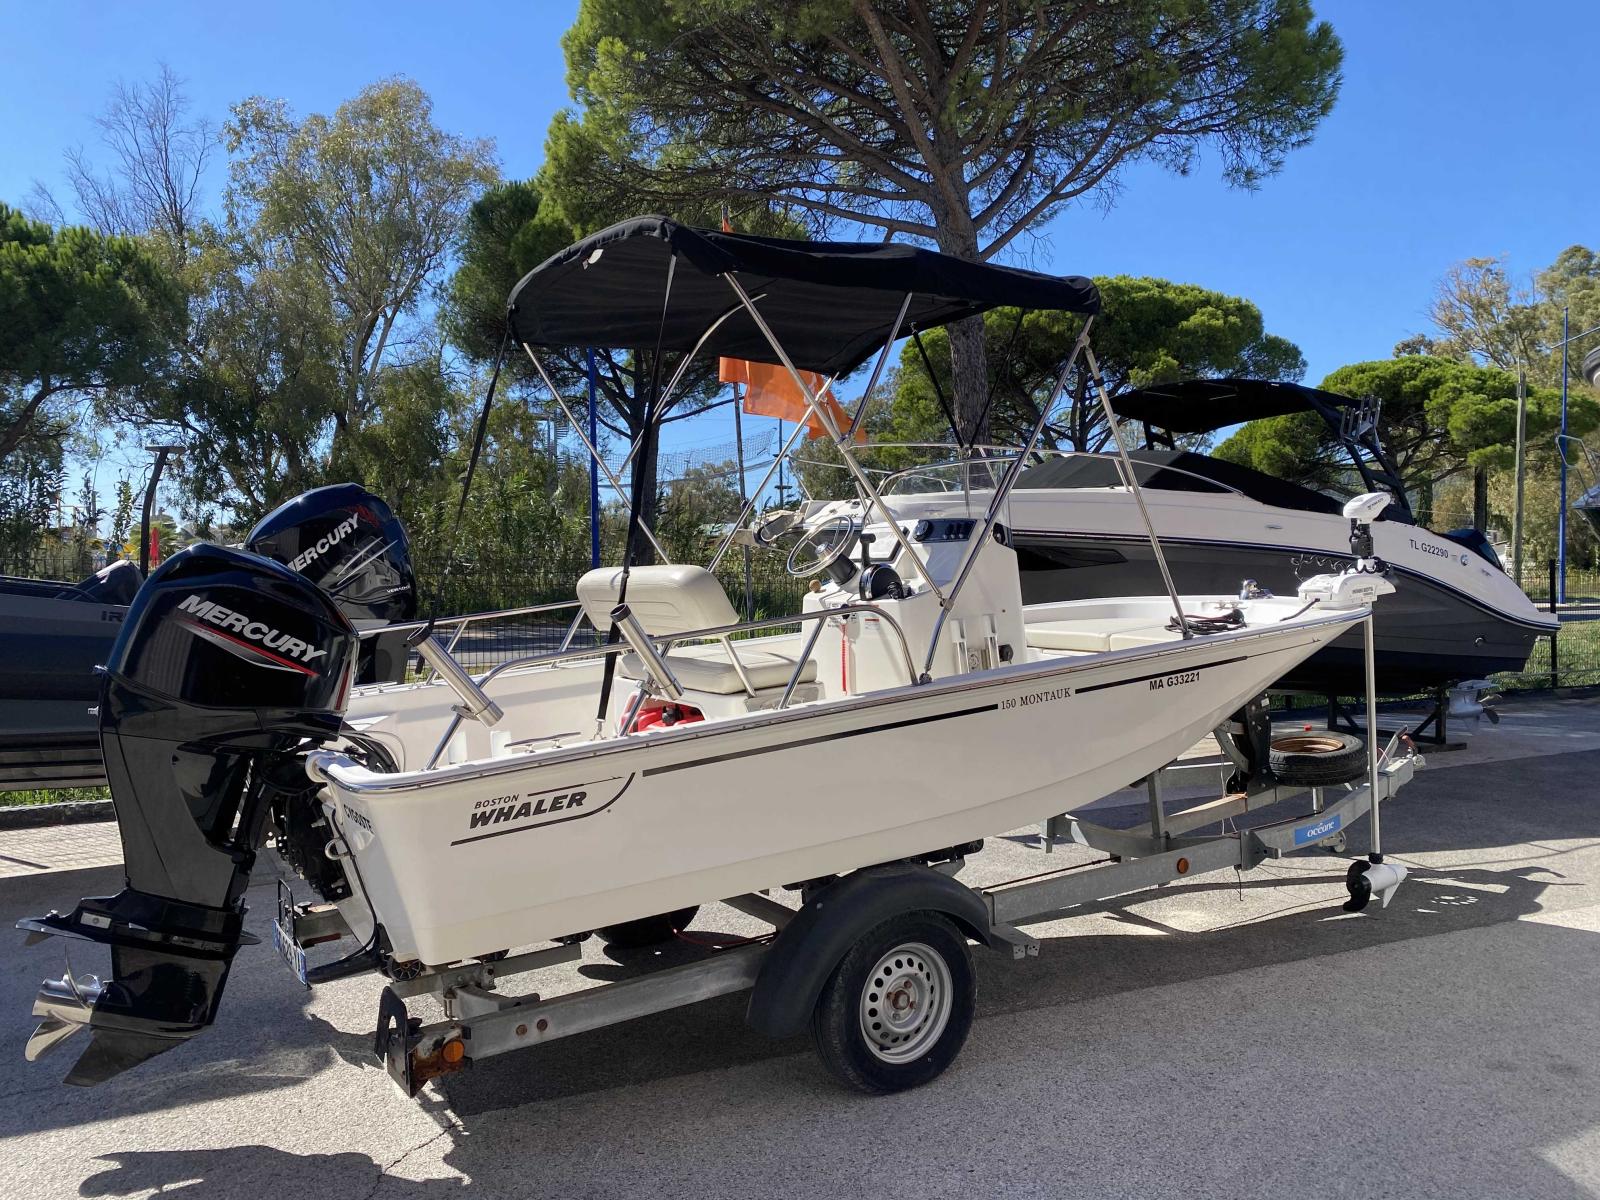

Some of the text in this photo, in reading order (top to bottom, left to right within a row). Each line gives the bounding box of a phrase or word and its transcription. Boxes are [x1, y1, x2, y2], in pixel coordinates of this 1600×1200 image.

[1409, 538, 1449, 559] TL G22290
[177, 594, 328, 663] MERCURY
[1149, 671, 1201, 691] MA G33221
[1001, 687, 1071, 710] 150 MONTAUK
[469, 791, 588, 830] WHALER
[474, 793, 519, 810] BOSTON
